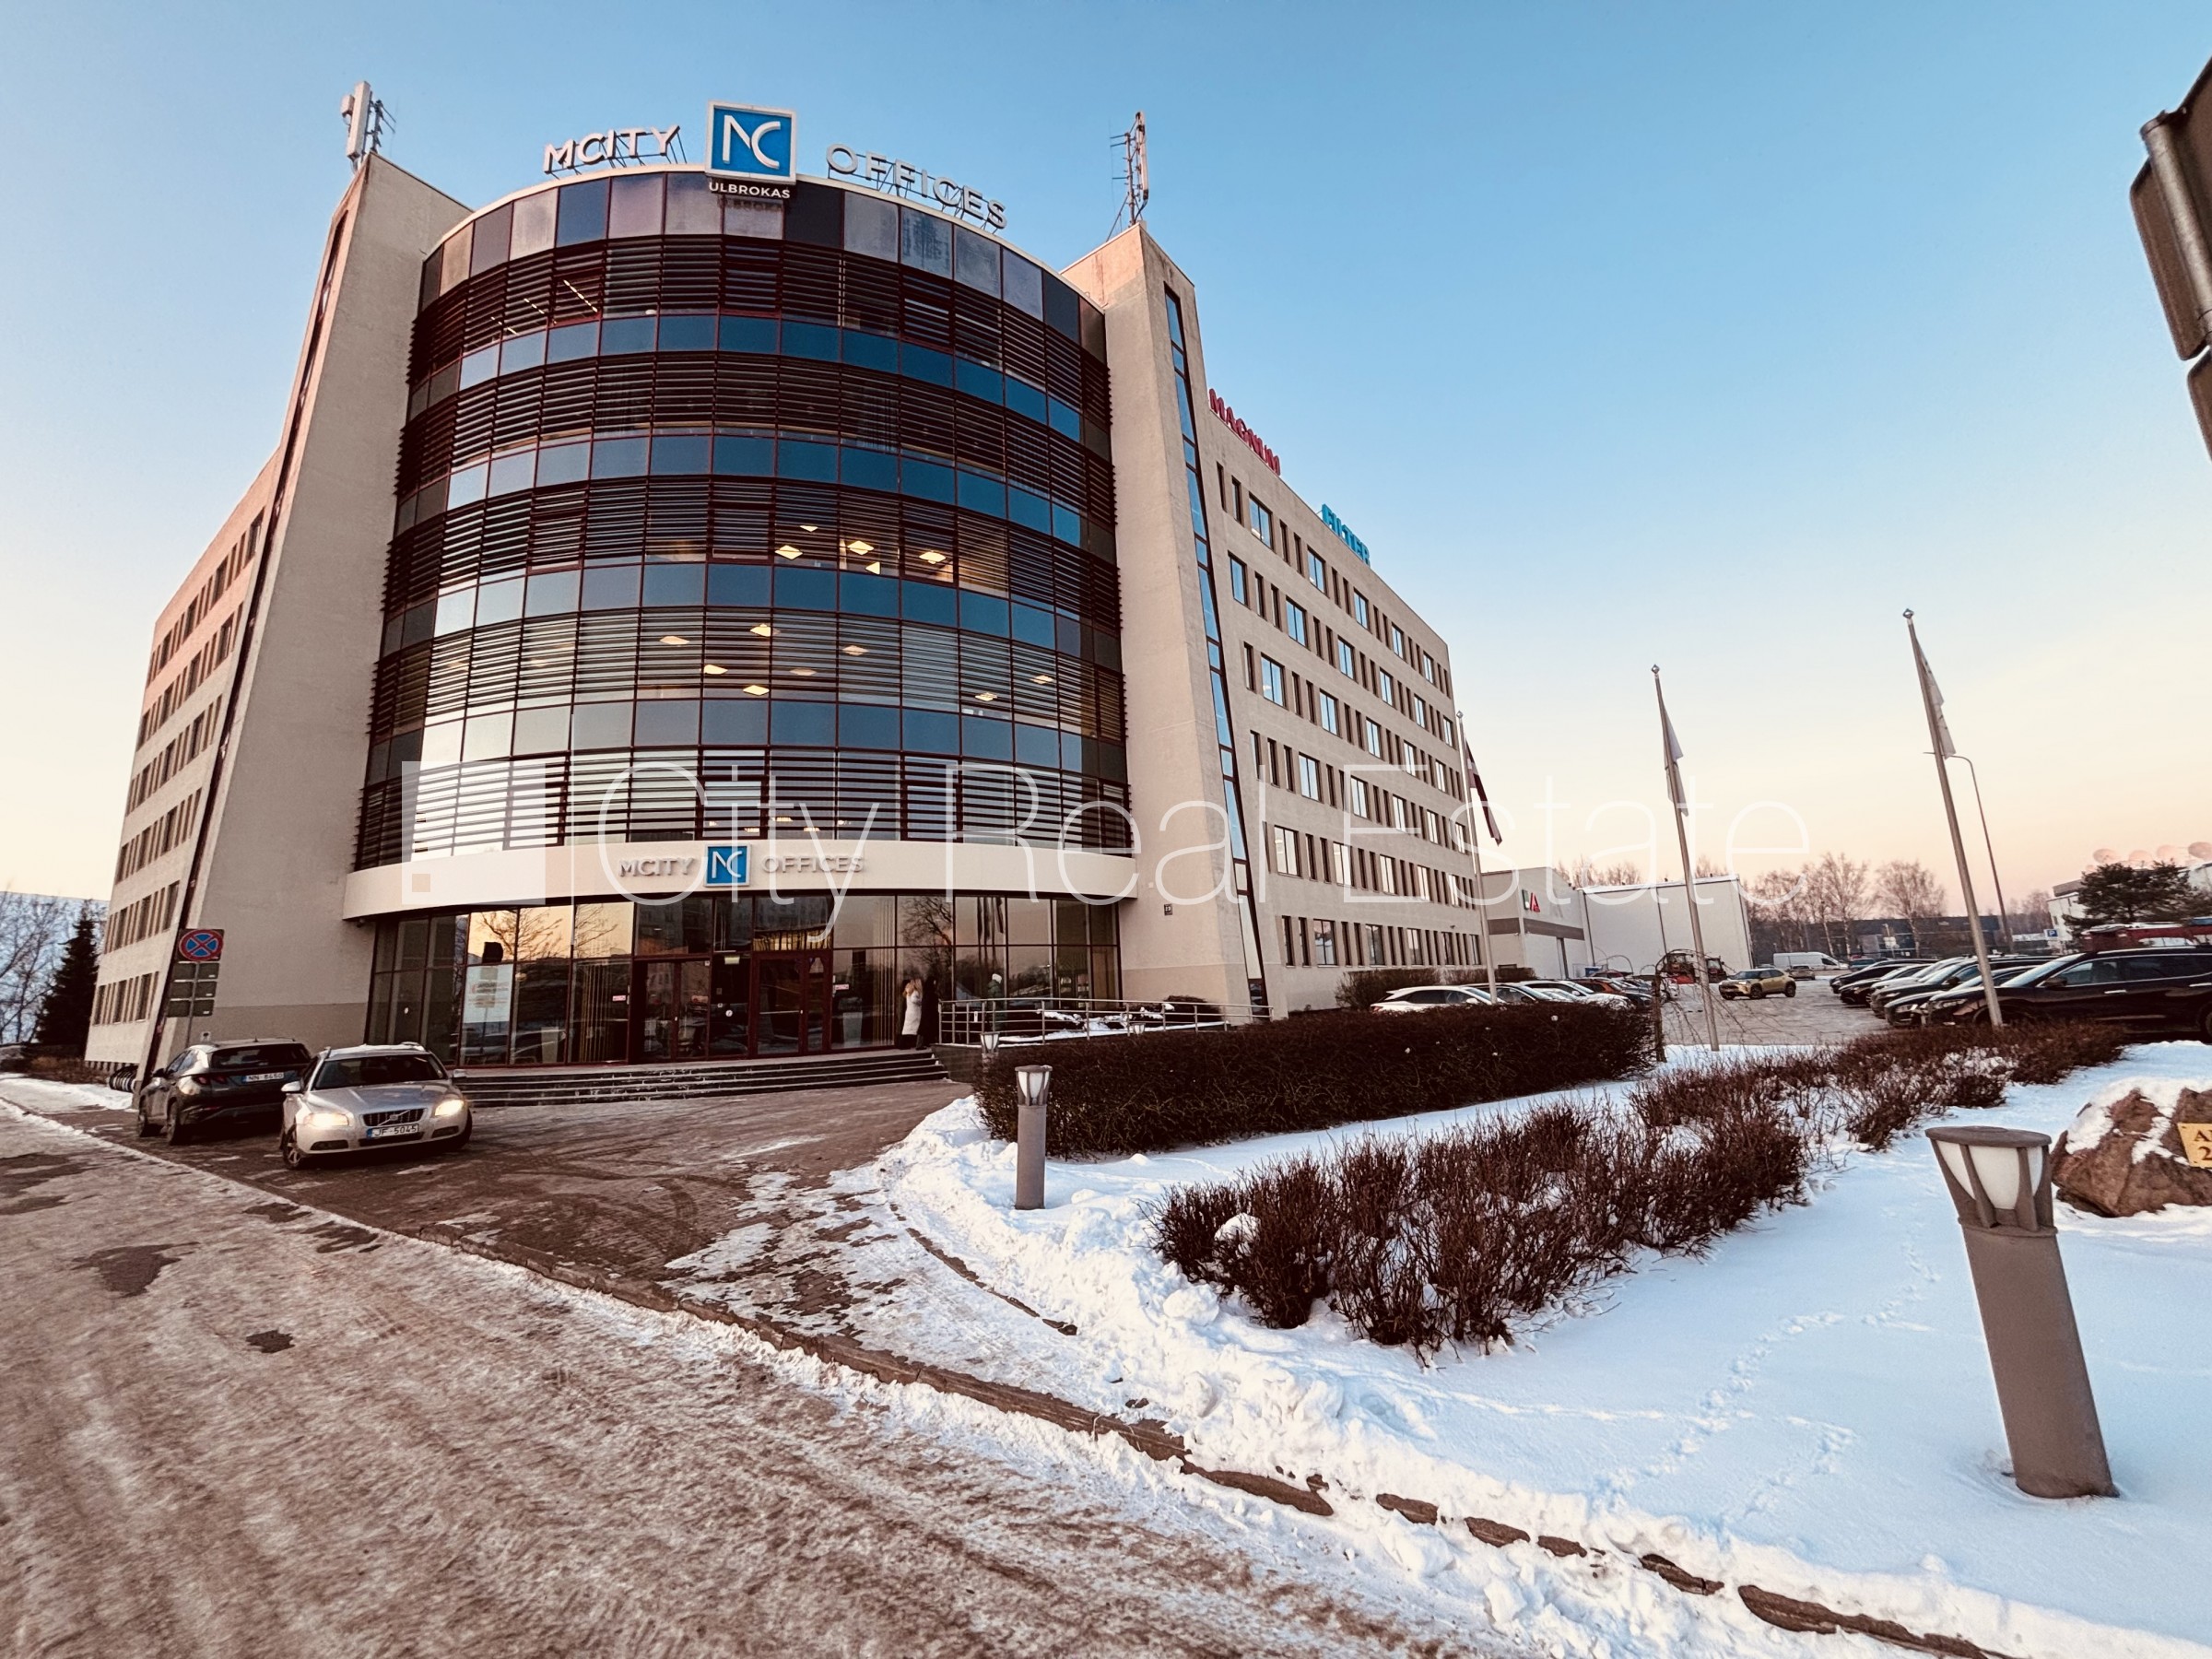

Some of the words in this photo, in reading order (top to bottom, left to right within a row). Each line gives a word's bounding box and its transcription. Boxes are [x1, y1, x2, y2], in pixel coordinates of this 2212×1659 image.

[543, 124, 680, 174] MCITY
[827, 143, 1007, 229] OFFICES
[709, 182, 790, 198] ULBROKAS
[1209, 388, 1281, 477] MAGNUM
[618, 857, 696, 877] MCITY
[761, 855, 864, 873] OFFICES
[374, 1124, 417, 1136] JF-5045
[2194, 1130, 2212, 1142] A
